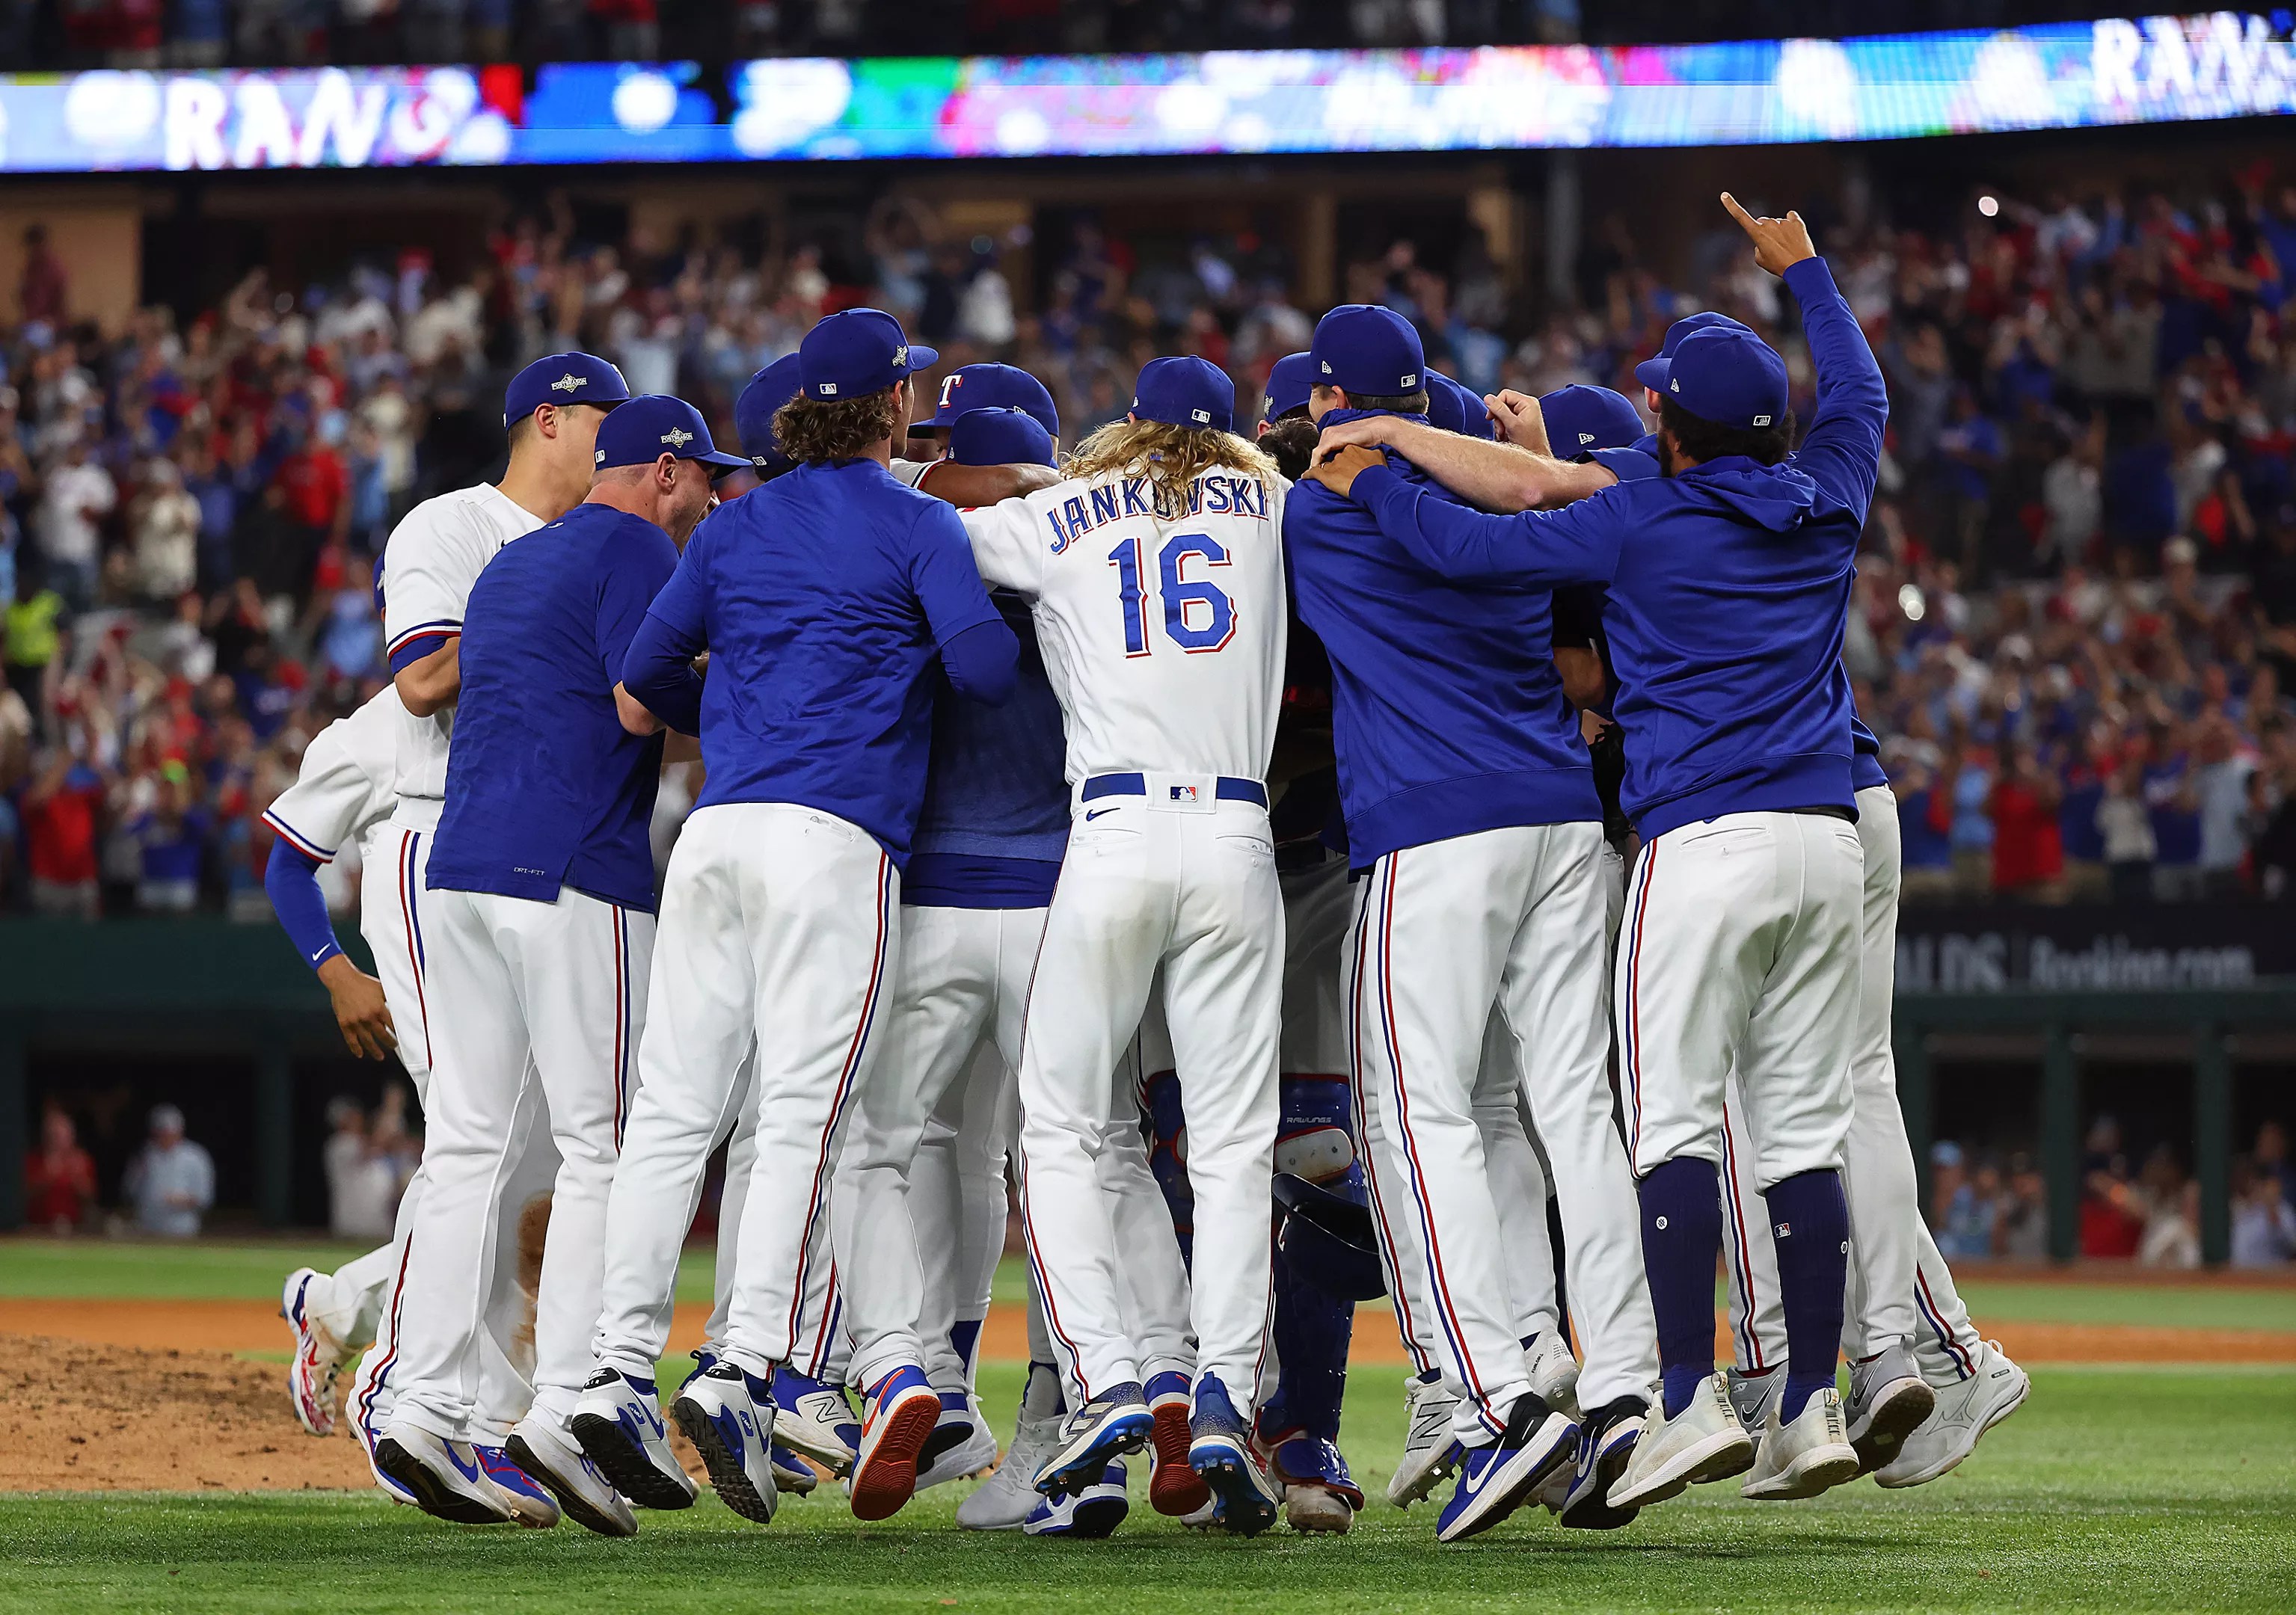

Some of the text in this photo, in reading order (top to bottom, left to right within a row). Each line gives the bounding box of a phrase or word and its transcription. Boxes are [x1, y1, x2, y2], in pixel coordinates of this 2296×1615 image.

[939, 375, 963, 408] T
[1106, 533, 1238, 659] 16
[514, 867, 546, 876] DRI-FIT
